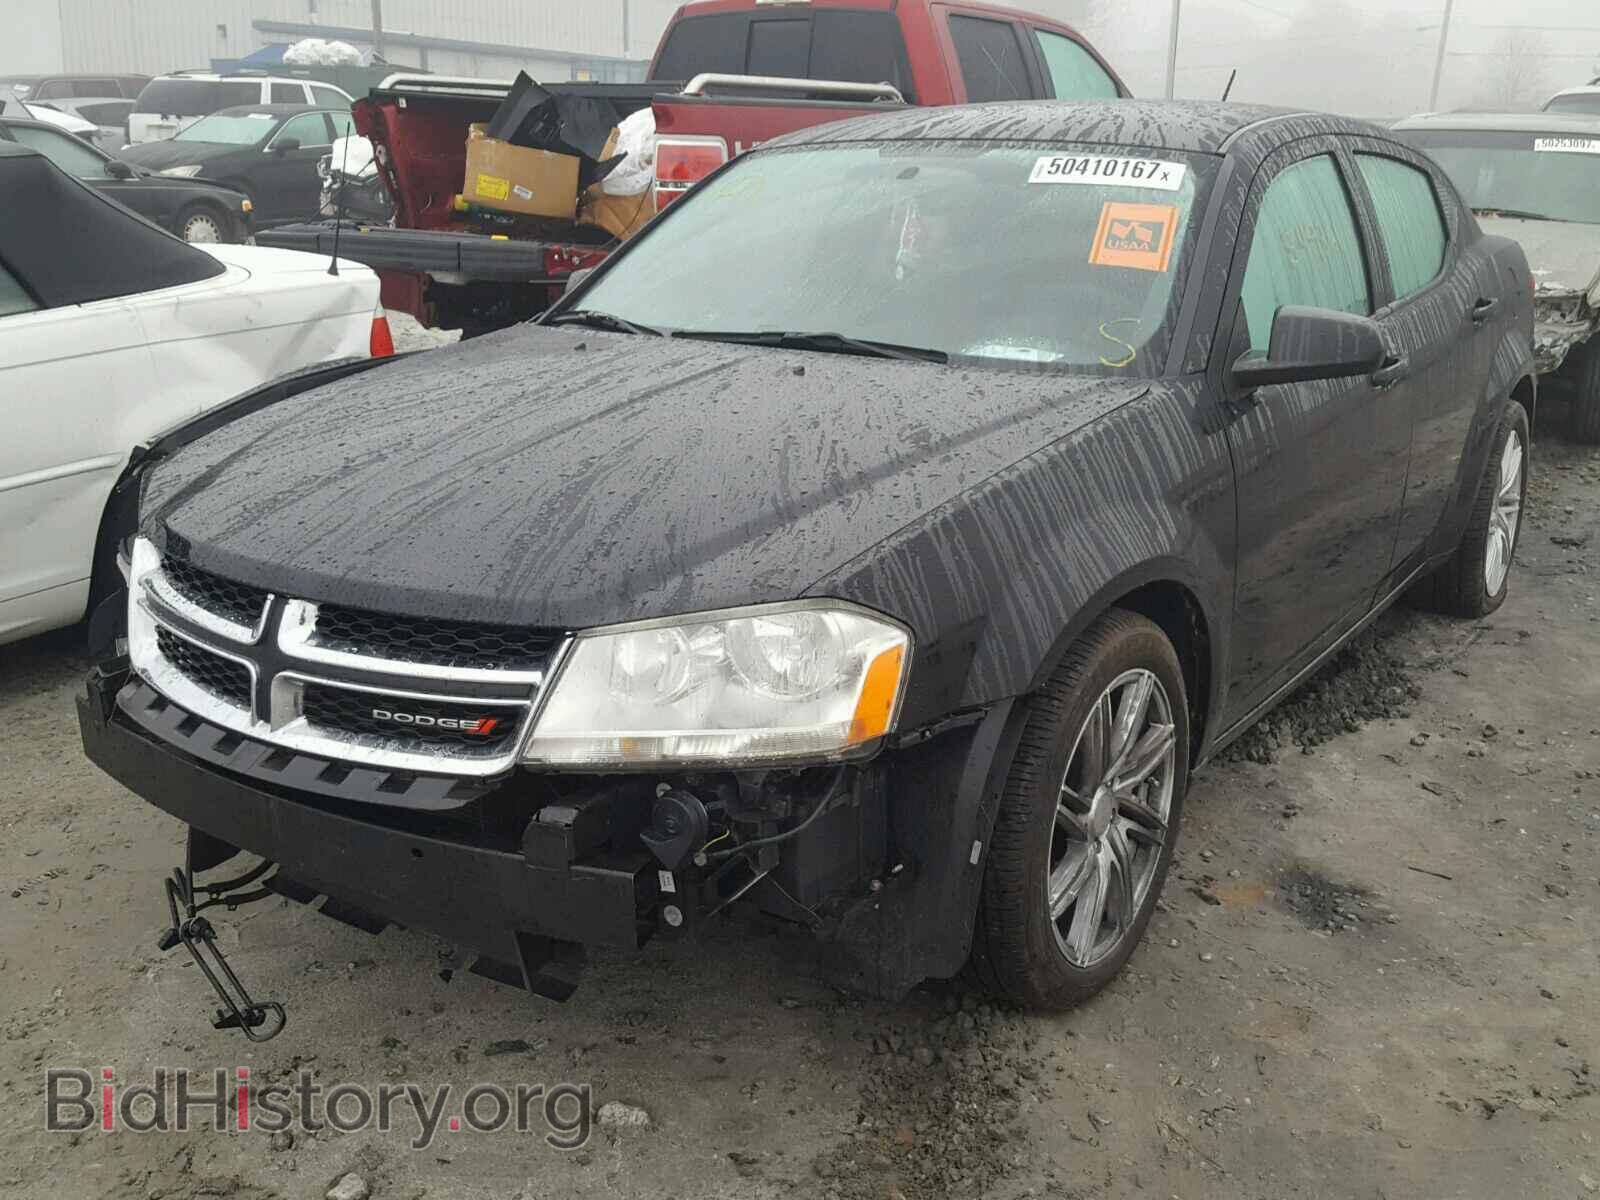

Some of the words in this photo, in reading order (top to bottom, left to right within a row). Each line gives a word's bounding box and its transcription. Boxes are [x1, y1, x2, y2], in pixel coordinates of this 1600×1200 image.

[1047, 157, 1161, 179] 50410167
[1106, 239, 1150, 250] USAA
[372, 708, 481, 730] DODGE
